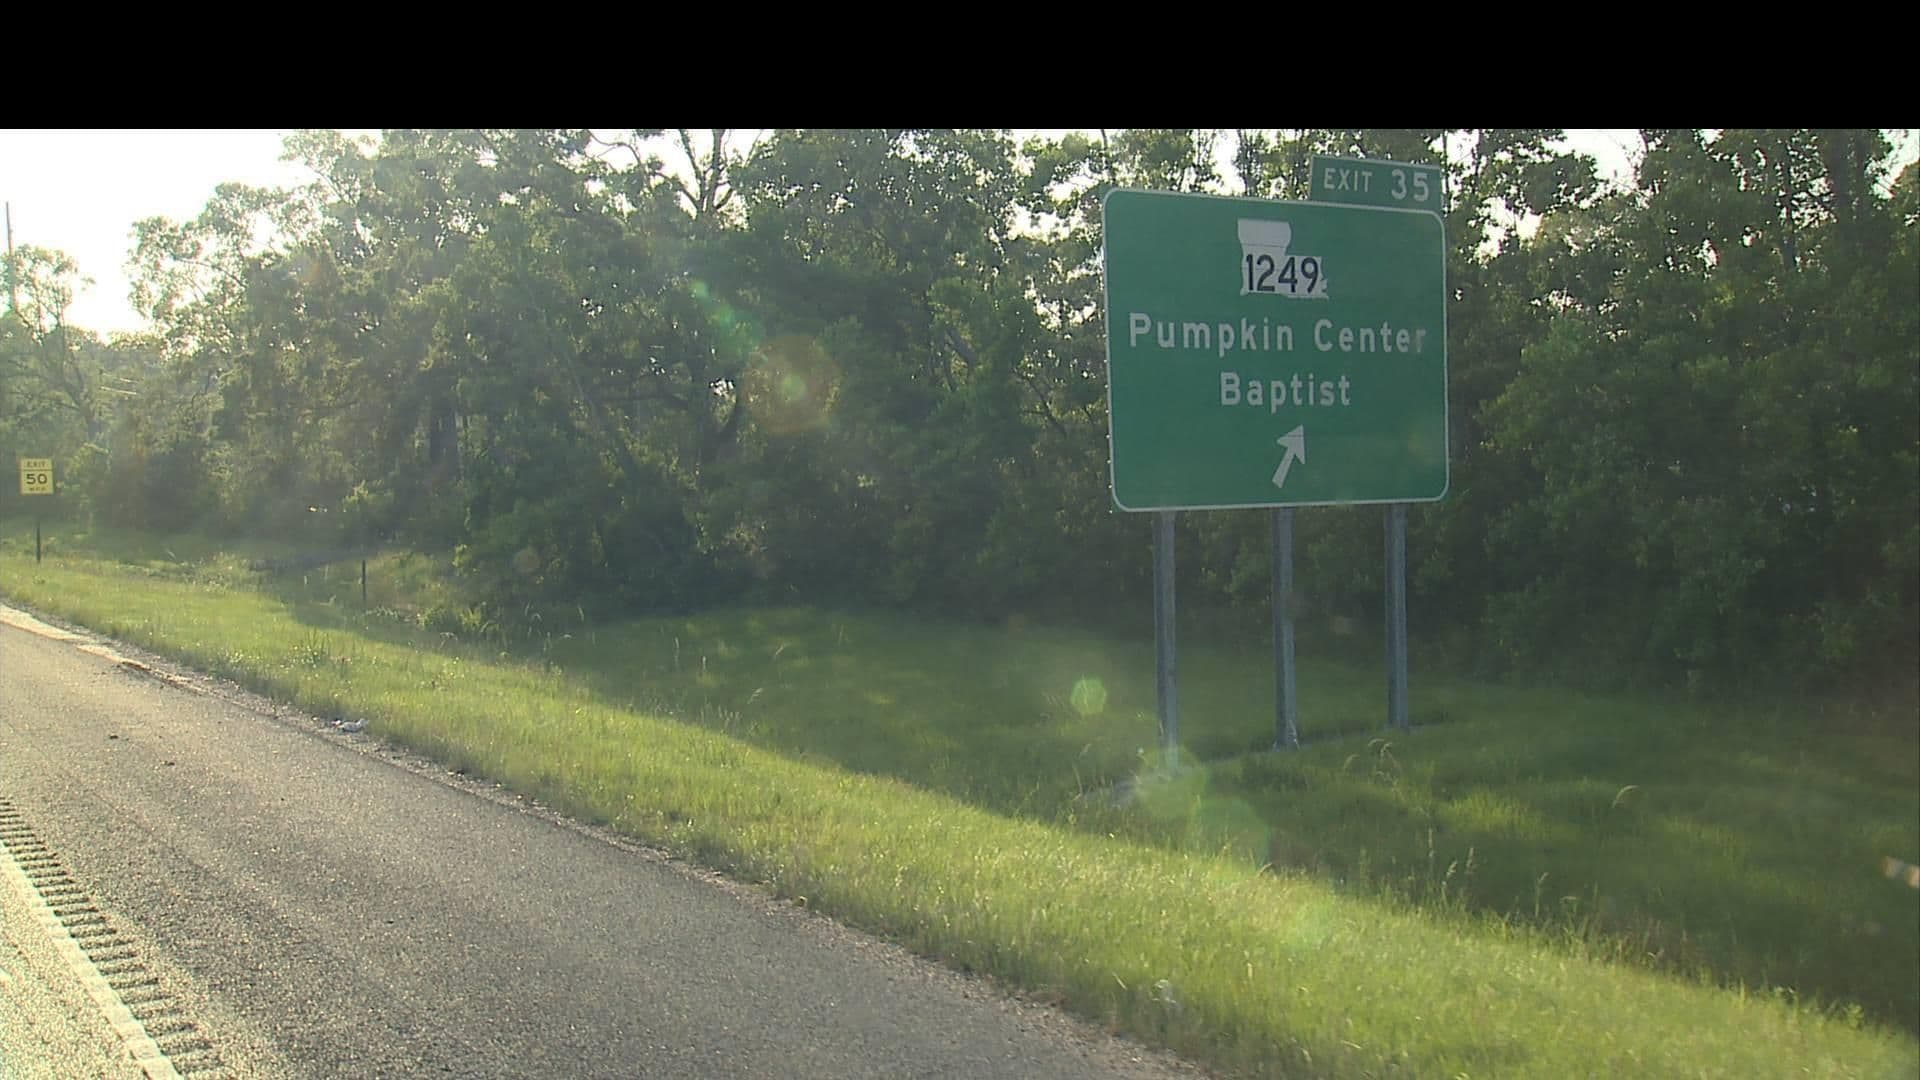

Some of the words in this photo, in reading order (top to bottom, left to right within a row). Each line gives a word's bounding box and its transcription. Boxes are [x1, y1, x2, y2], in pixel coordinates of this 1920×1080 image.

[1323, 167, 1373, 193] EXIT
[1391, 168, 1430, 202] 35
[1246, 253, 1319, 294] 1249
[1129, 312, 1294, 358] Pumpkin
[1313, 318, 1427, 353] Center
[1220, 371, 1351, 414] Baptist
[26, 473, 48, 485] 50
